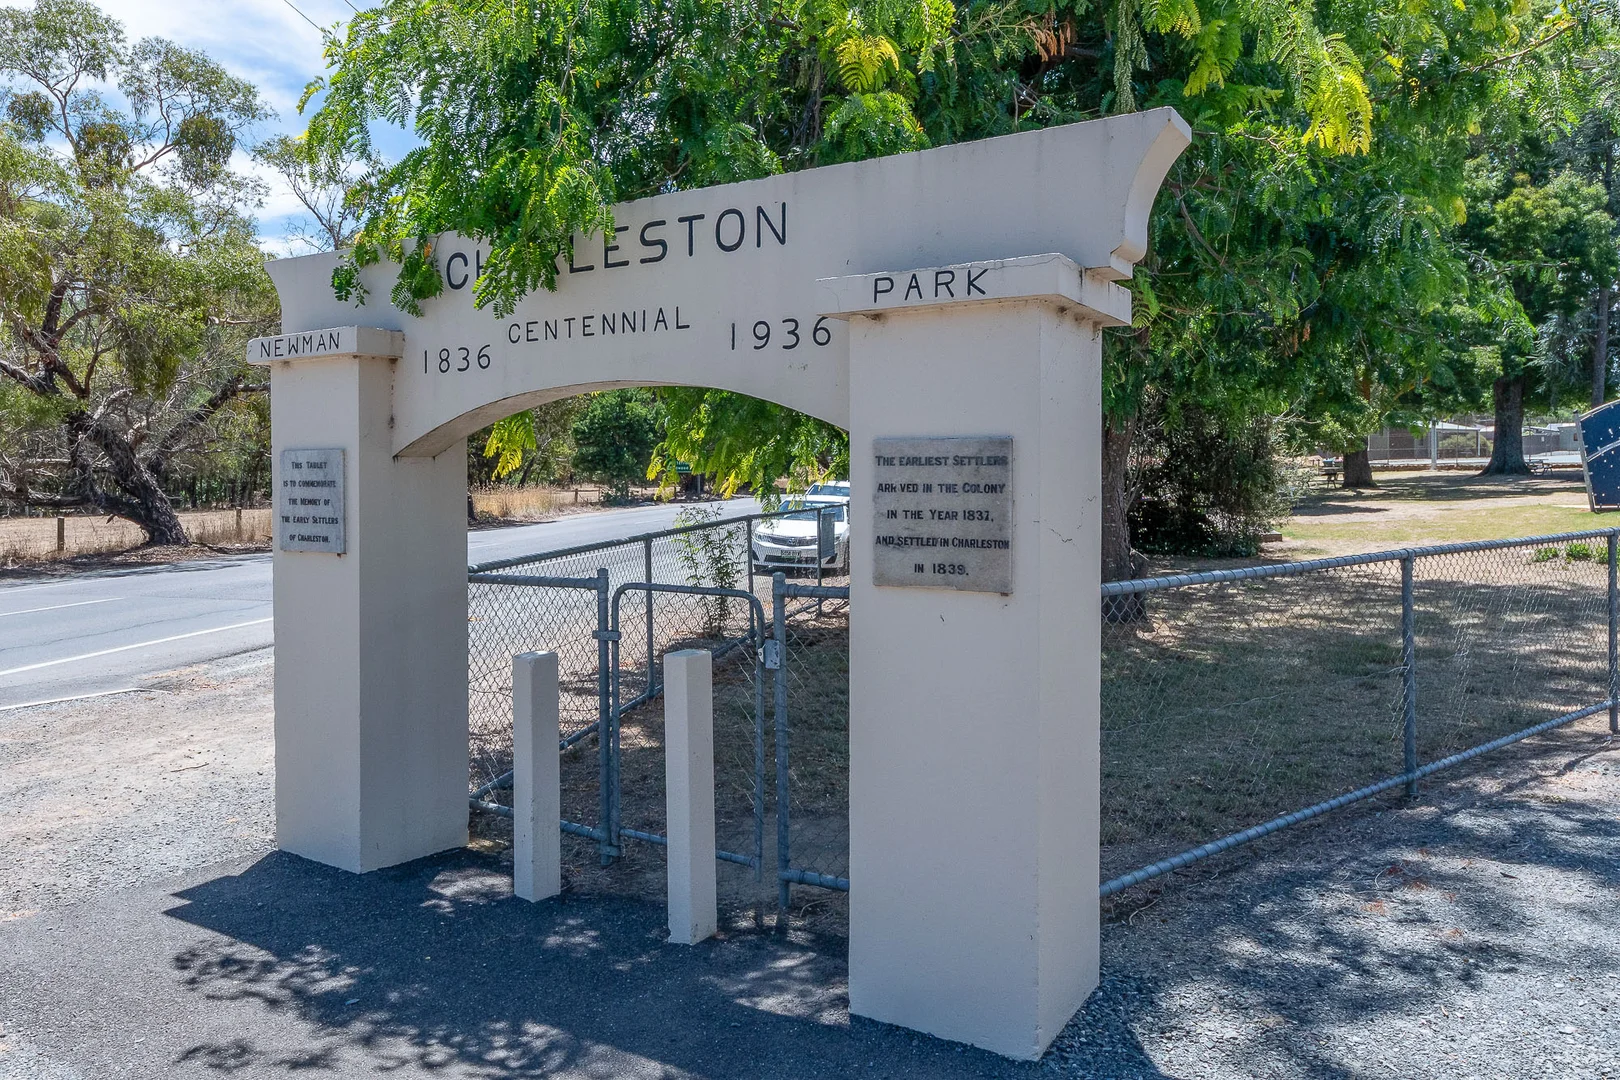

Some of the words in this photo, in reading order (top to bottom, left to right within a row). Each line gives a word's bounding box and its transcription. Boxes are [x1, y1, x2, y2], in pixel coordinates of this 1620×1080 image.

[874, 269, 988, 303] PARK
[508, 306, 690, 345] CENTENNIAL
[731, 316, 832, 351] 1936
[260, 332, 340, 358] NEWMAN
[424, 344, 491, 374] 1836
[306, 461, 327, 469] TABLET
[899, 456, 949, 467] EARLIEST
[952, 455, 1008, 467] SETTLERS
[290, 480, 297, 488] TO
[922, 483, 932, 493] IN
[937, 483, 958, 494] THE
[962, 482, 1006, 494] COLONY
[293, 515, 310, 524] EARLY
[312, 515, 339, 525] SETTLERS
[886, 509, 898, 519] IN
[902, 509, 924, 520] THE
[929, 509, 958, 521] YEAR
[939, 537, 949, 548] IN
[951, 536, 1010, 550] CHARLESTON
[914, 563, 924, 573] IN
[932, 563, 969, 576] 1839.
